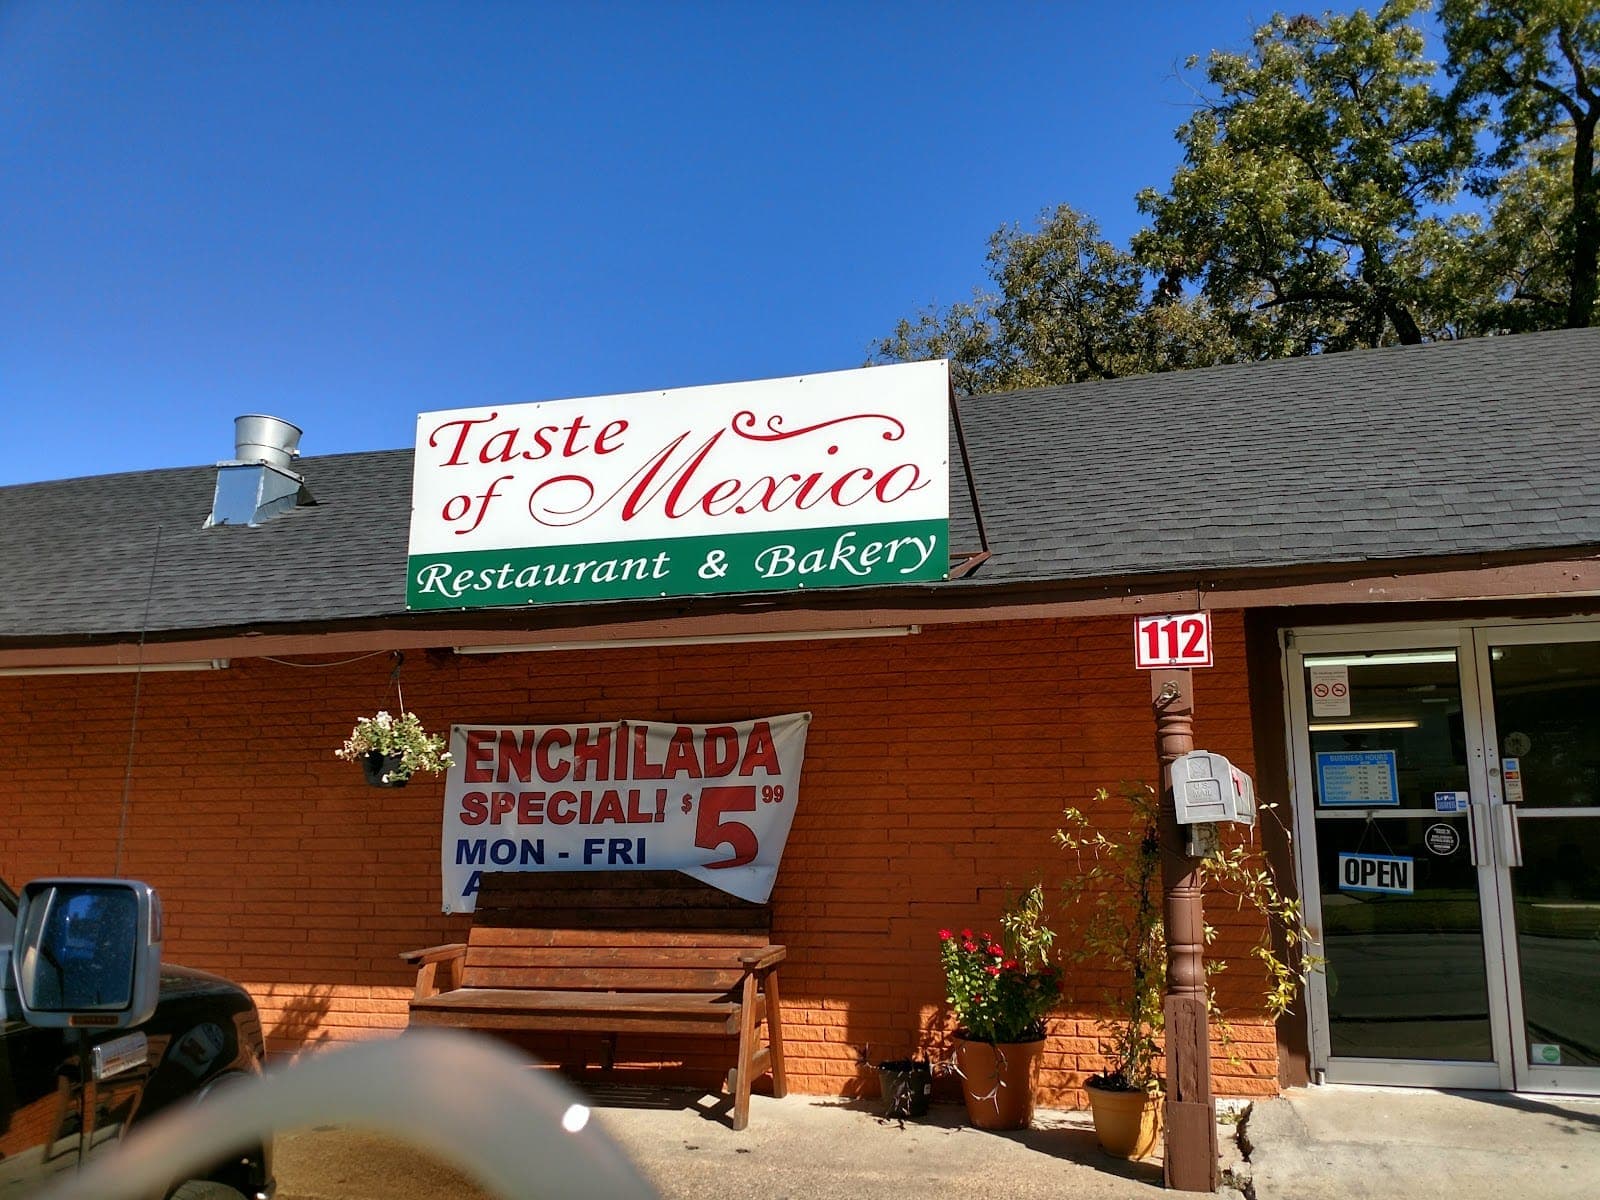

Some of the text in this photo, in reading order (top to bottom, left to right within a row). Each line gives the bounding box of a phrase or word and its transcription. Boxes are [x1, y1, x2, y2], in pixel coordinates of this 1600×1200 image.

[429, 412, 629, 467] Taste
[442, 426, 931, 535] of Mexico
[416, 530, 937, 598] Restaurant & Bakery
[1142, 619, 1204, 659] 112
[464, 721, 782, 784] ENCHILADA
[459, 788, 668, 826] SPECIAL!
[455, 838, 545, 866] MON
[583, 837, 647, 865] FRI
[1344, 858, 1408, 889] OPEN
